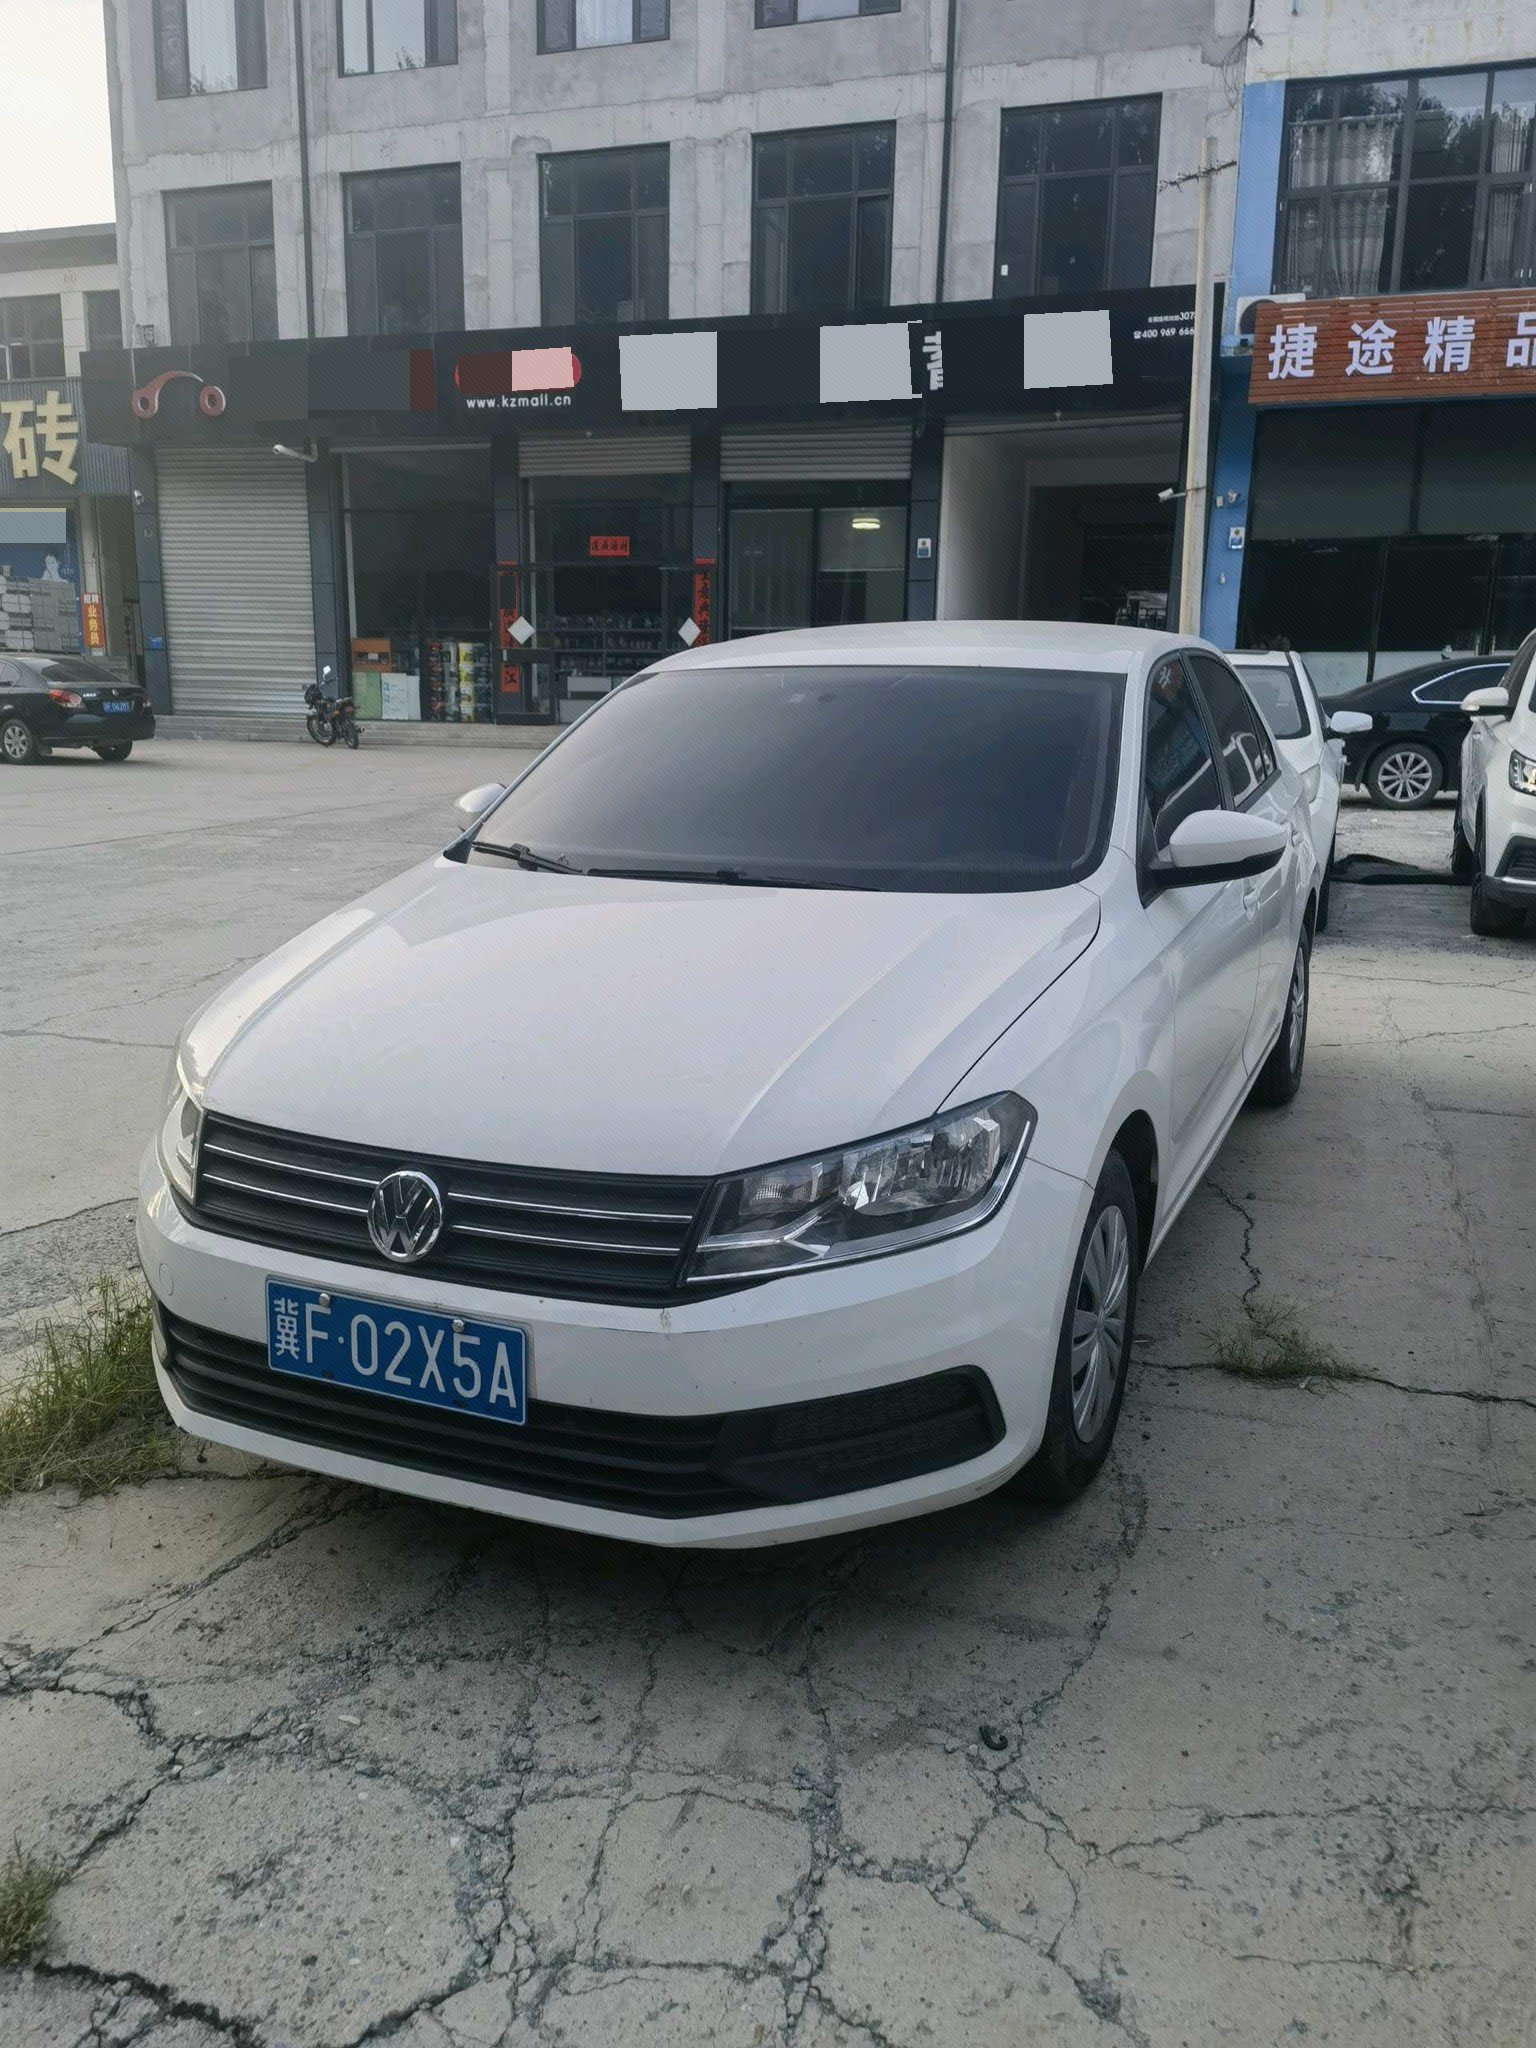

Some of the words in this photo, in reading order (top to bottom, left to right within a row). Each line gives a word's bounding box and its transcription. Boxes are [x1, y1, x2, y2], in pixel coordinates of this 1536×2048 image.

[1268, 311, 1536, 380] 捷途精品
[466, 393, 571, 408] www.kzmall.cn
[1, 390, 79, 485] 砖
